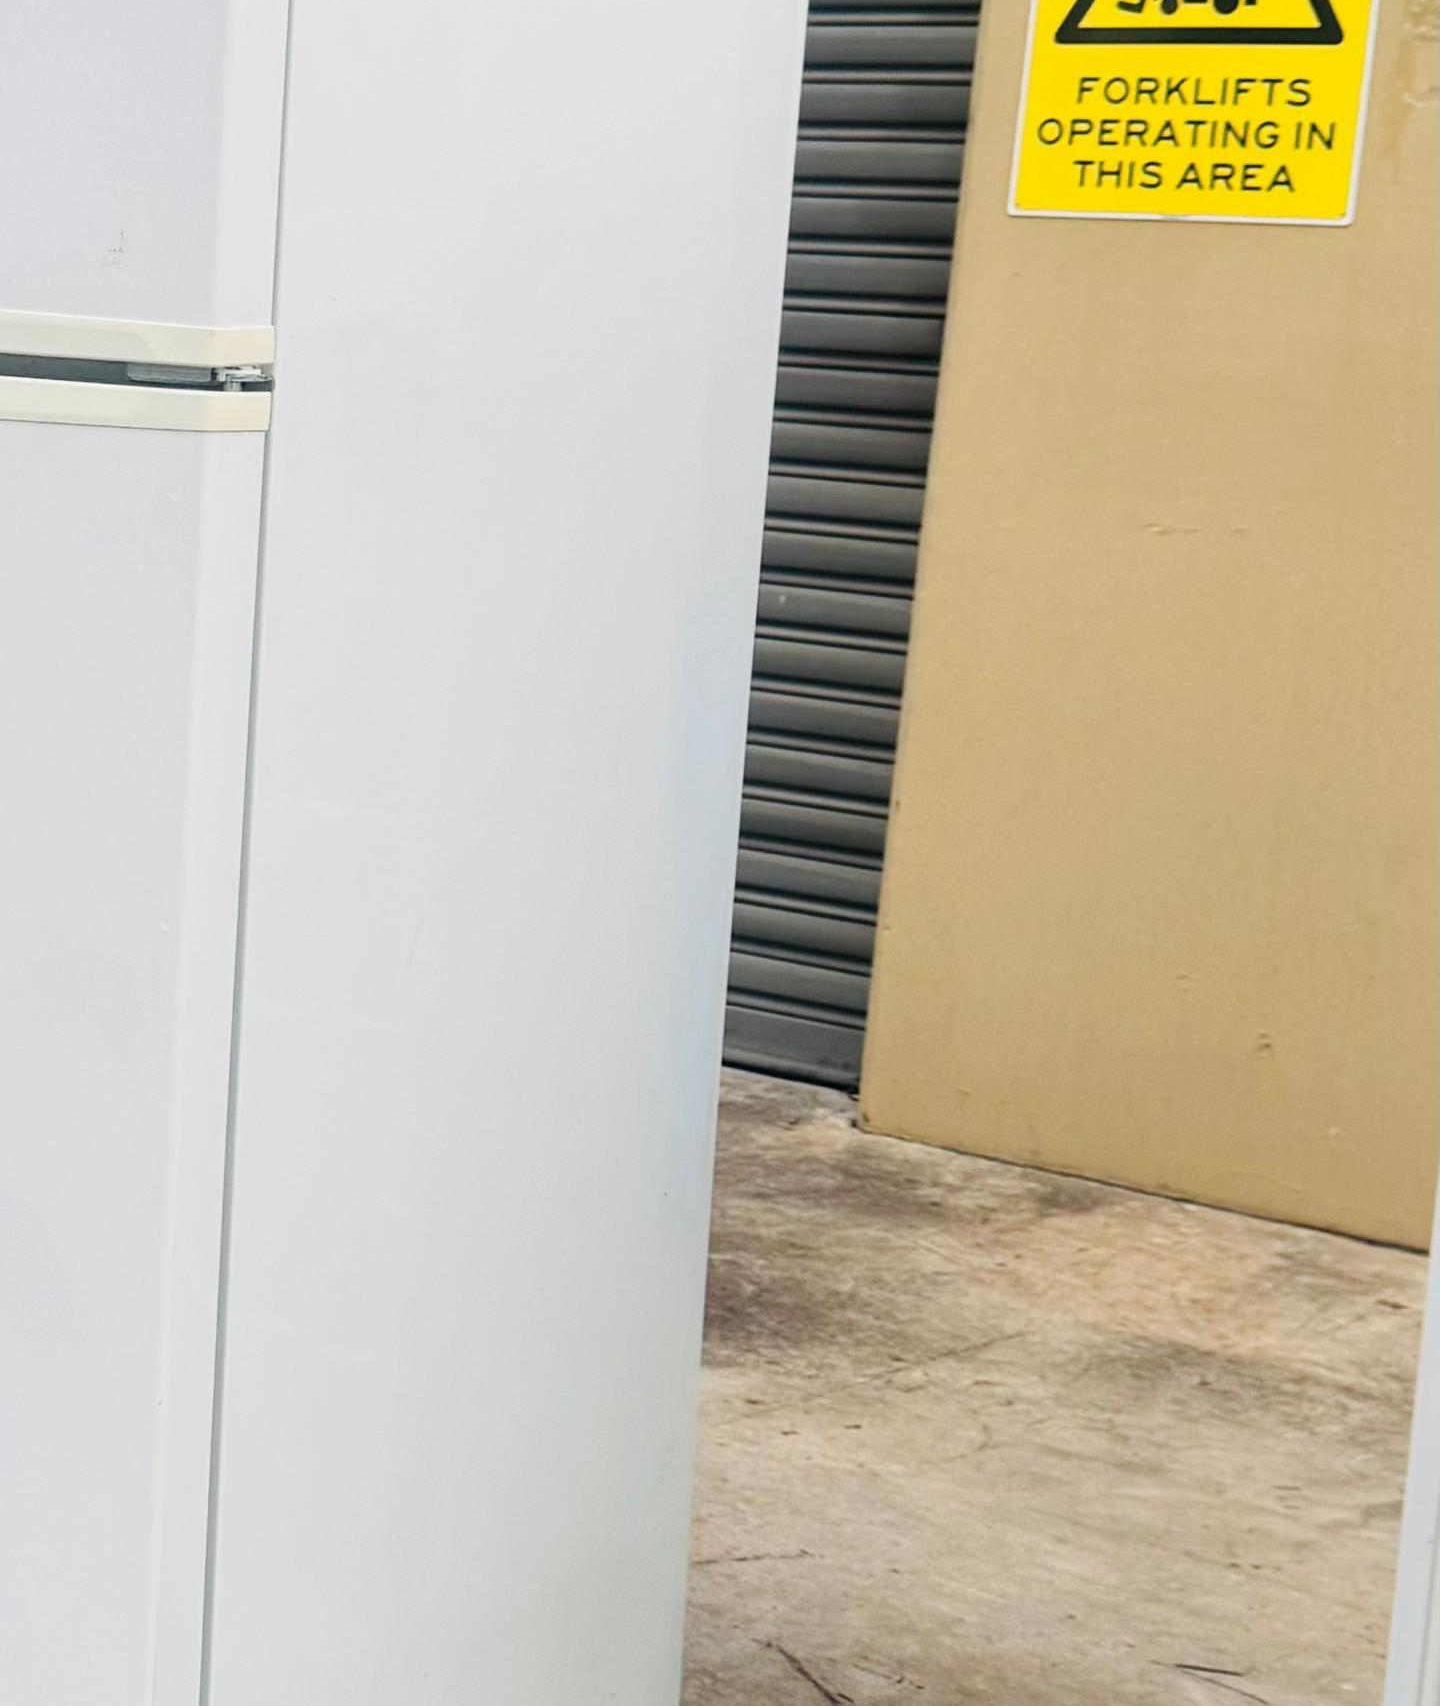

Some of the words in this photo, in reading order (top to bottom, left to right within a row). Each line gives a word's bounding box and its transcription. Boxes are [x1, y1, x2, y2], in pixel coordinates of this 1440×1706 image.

[1076, 76, 1312, 107] FORKLIFTS
[1037, 117, 1280, 150] OPERATING
[1293, 121, 1337, 151] IN
[1072, 160, 1163, 189] THIS
[1174, 162, 1296, 193] AREA
